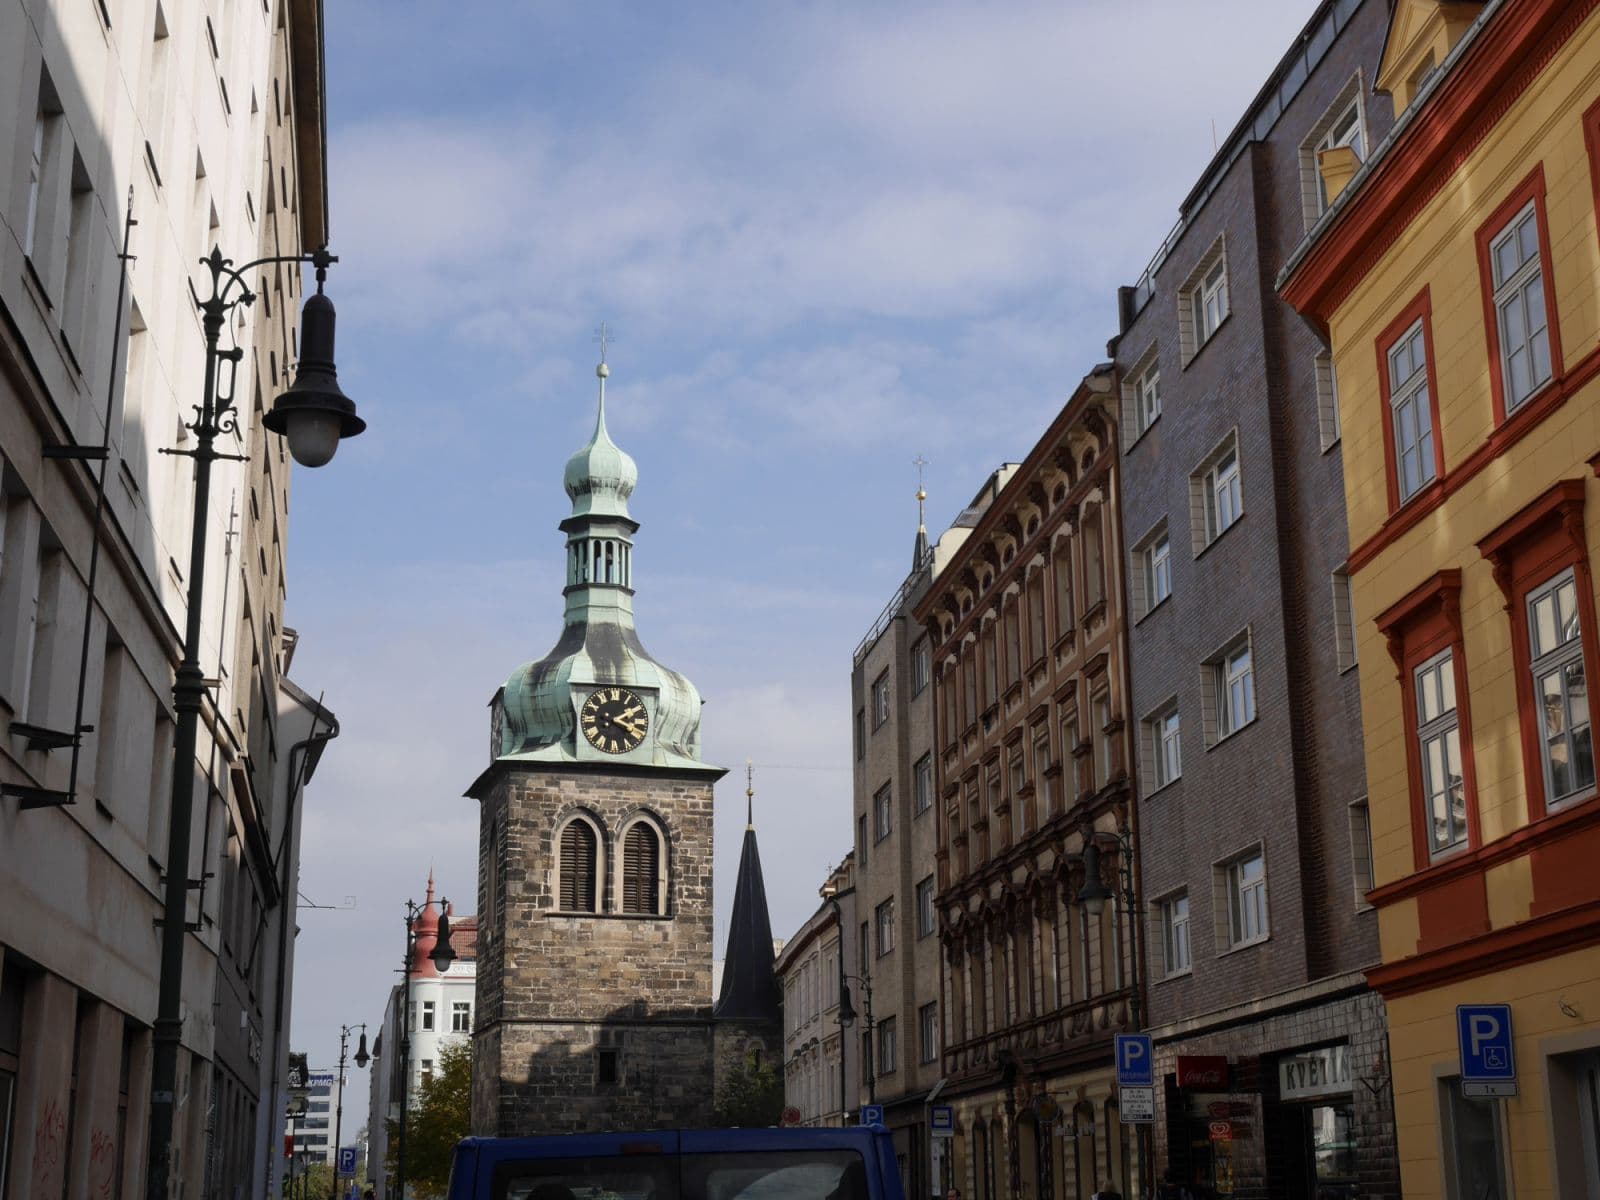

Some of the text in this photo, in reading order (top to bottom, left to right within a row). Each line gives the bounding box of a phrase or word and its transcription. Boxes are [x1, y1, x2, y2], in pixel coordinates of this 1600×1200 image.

[1469, 1014, 1500, 1056] P
[1124, 1040, 1144, 1070] P
[866, 1108, 879, 1123] P
[343, 1151, 354, 1166] P
